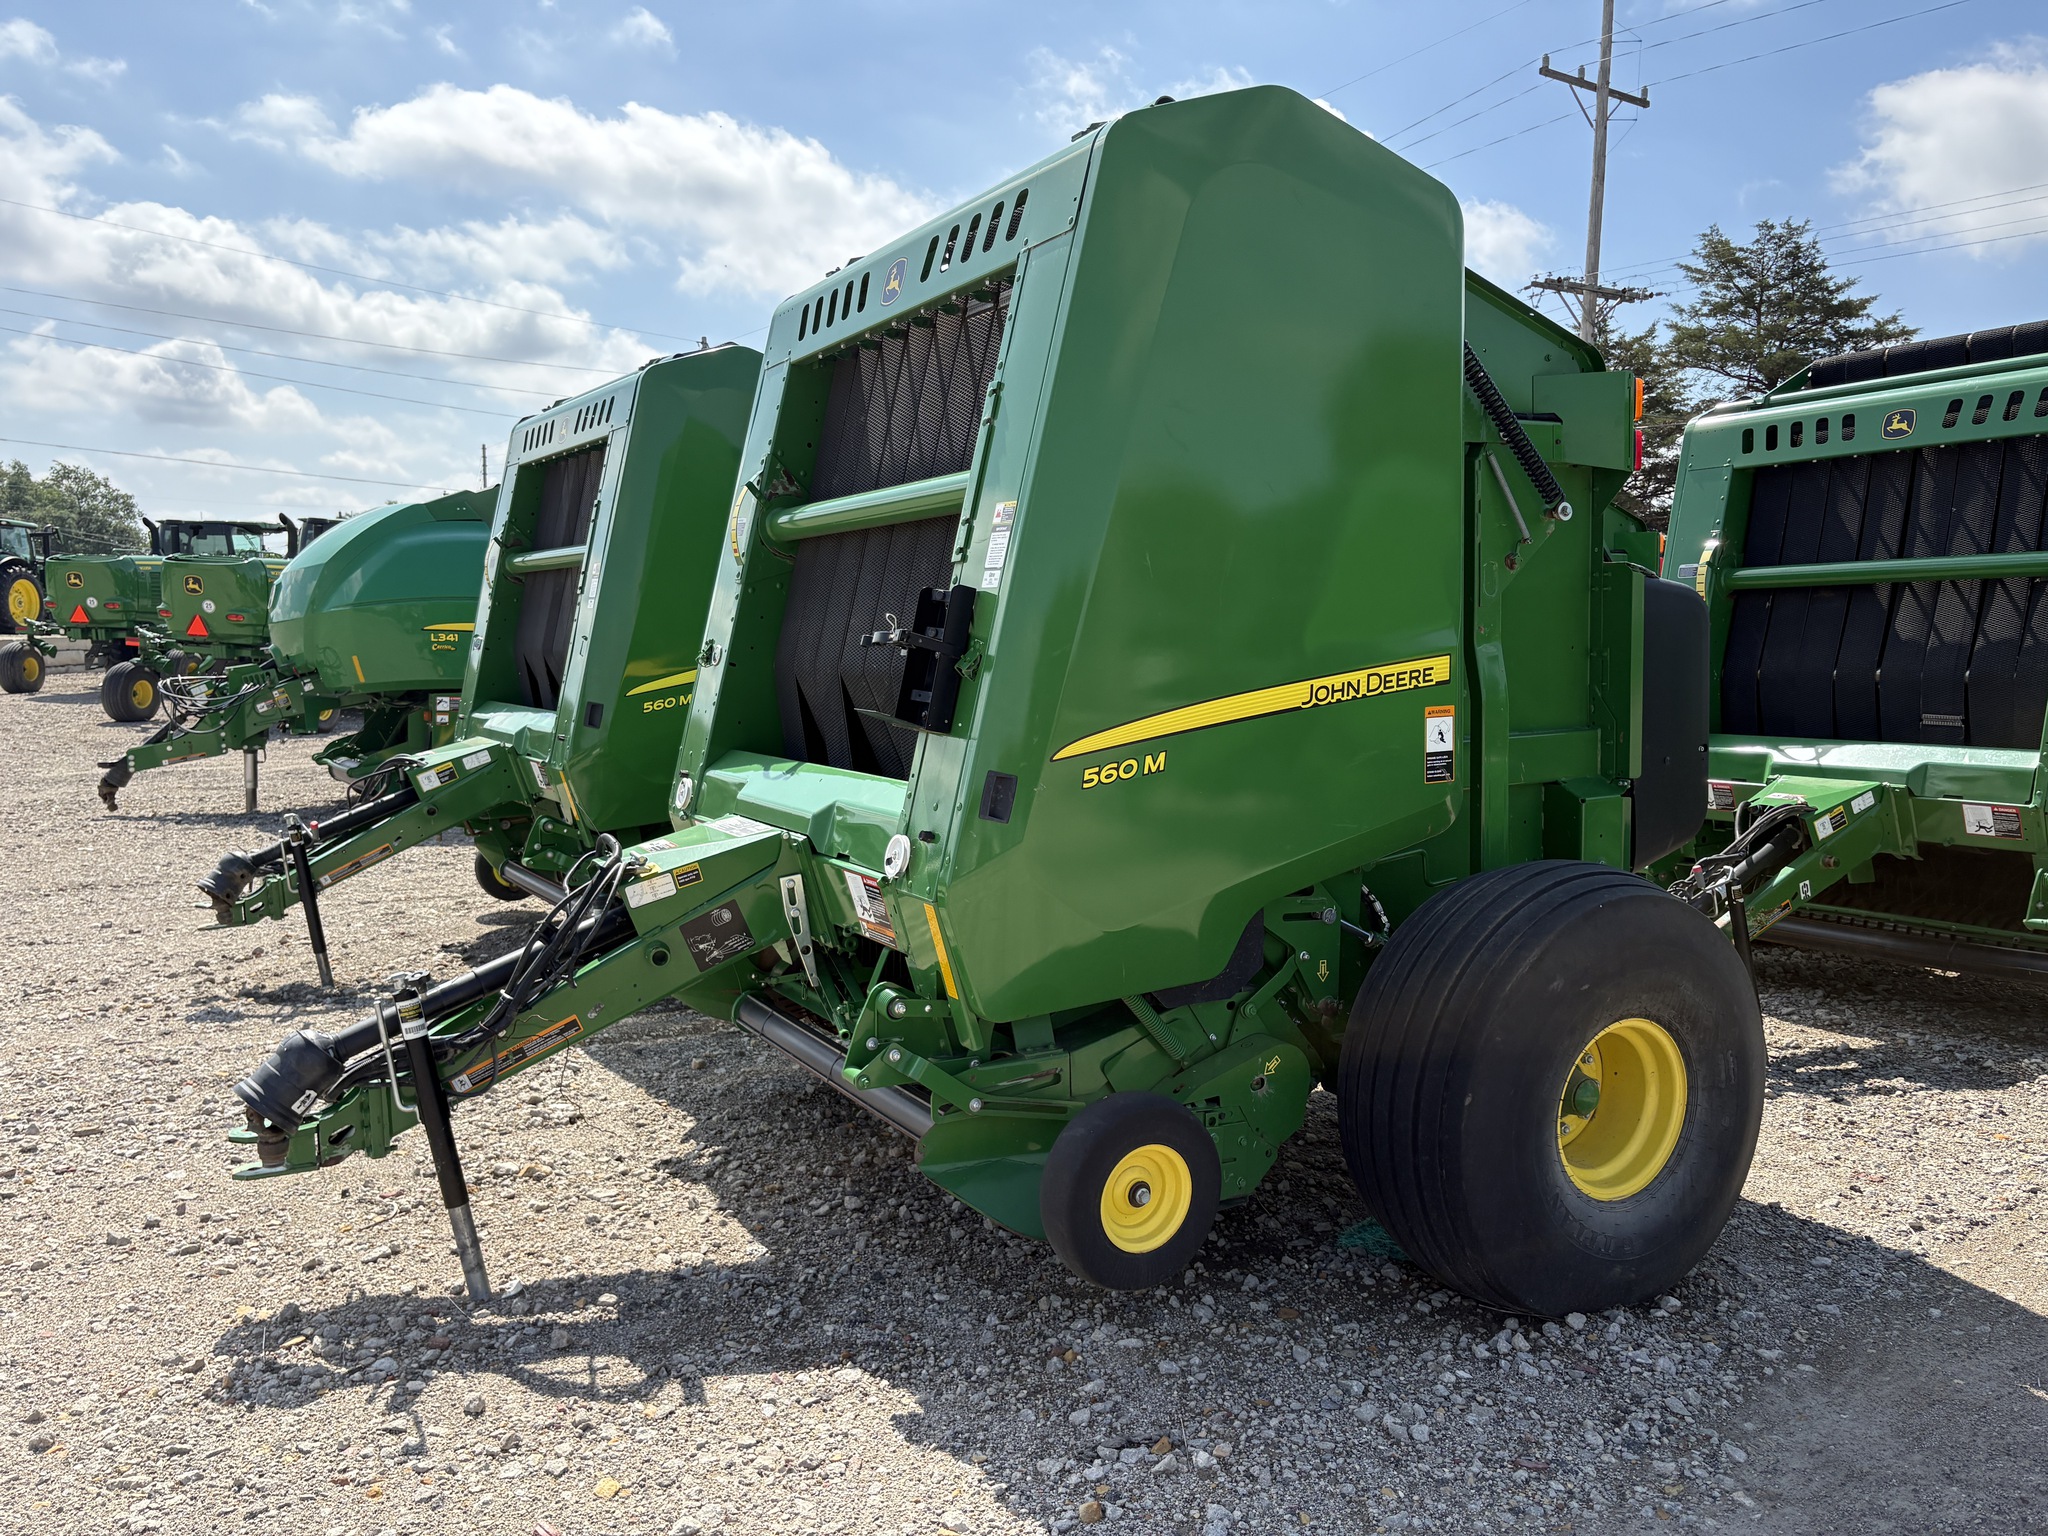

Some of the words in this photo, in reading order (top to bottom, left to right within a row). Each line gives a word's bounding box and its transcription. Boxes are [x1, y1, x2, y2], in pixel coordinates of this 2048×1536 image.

[430, 633, 459, 642] L341
[1301, 679, 1361, 706] JOHN
[1366, 666, 1435, 694] DEERE
[643, 697, 676, 713] 560
[679, 693, 693, 706] M
[1081, 757, 1139, 790] 560
[1142, 750, 1167, 776] M
